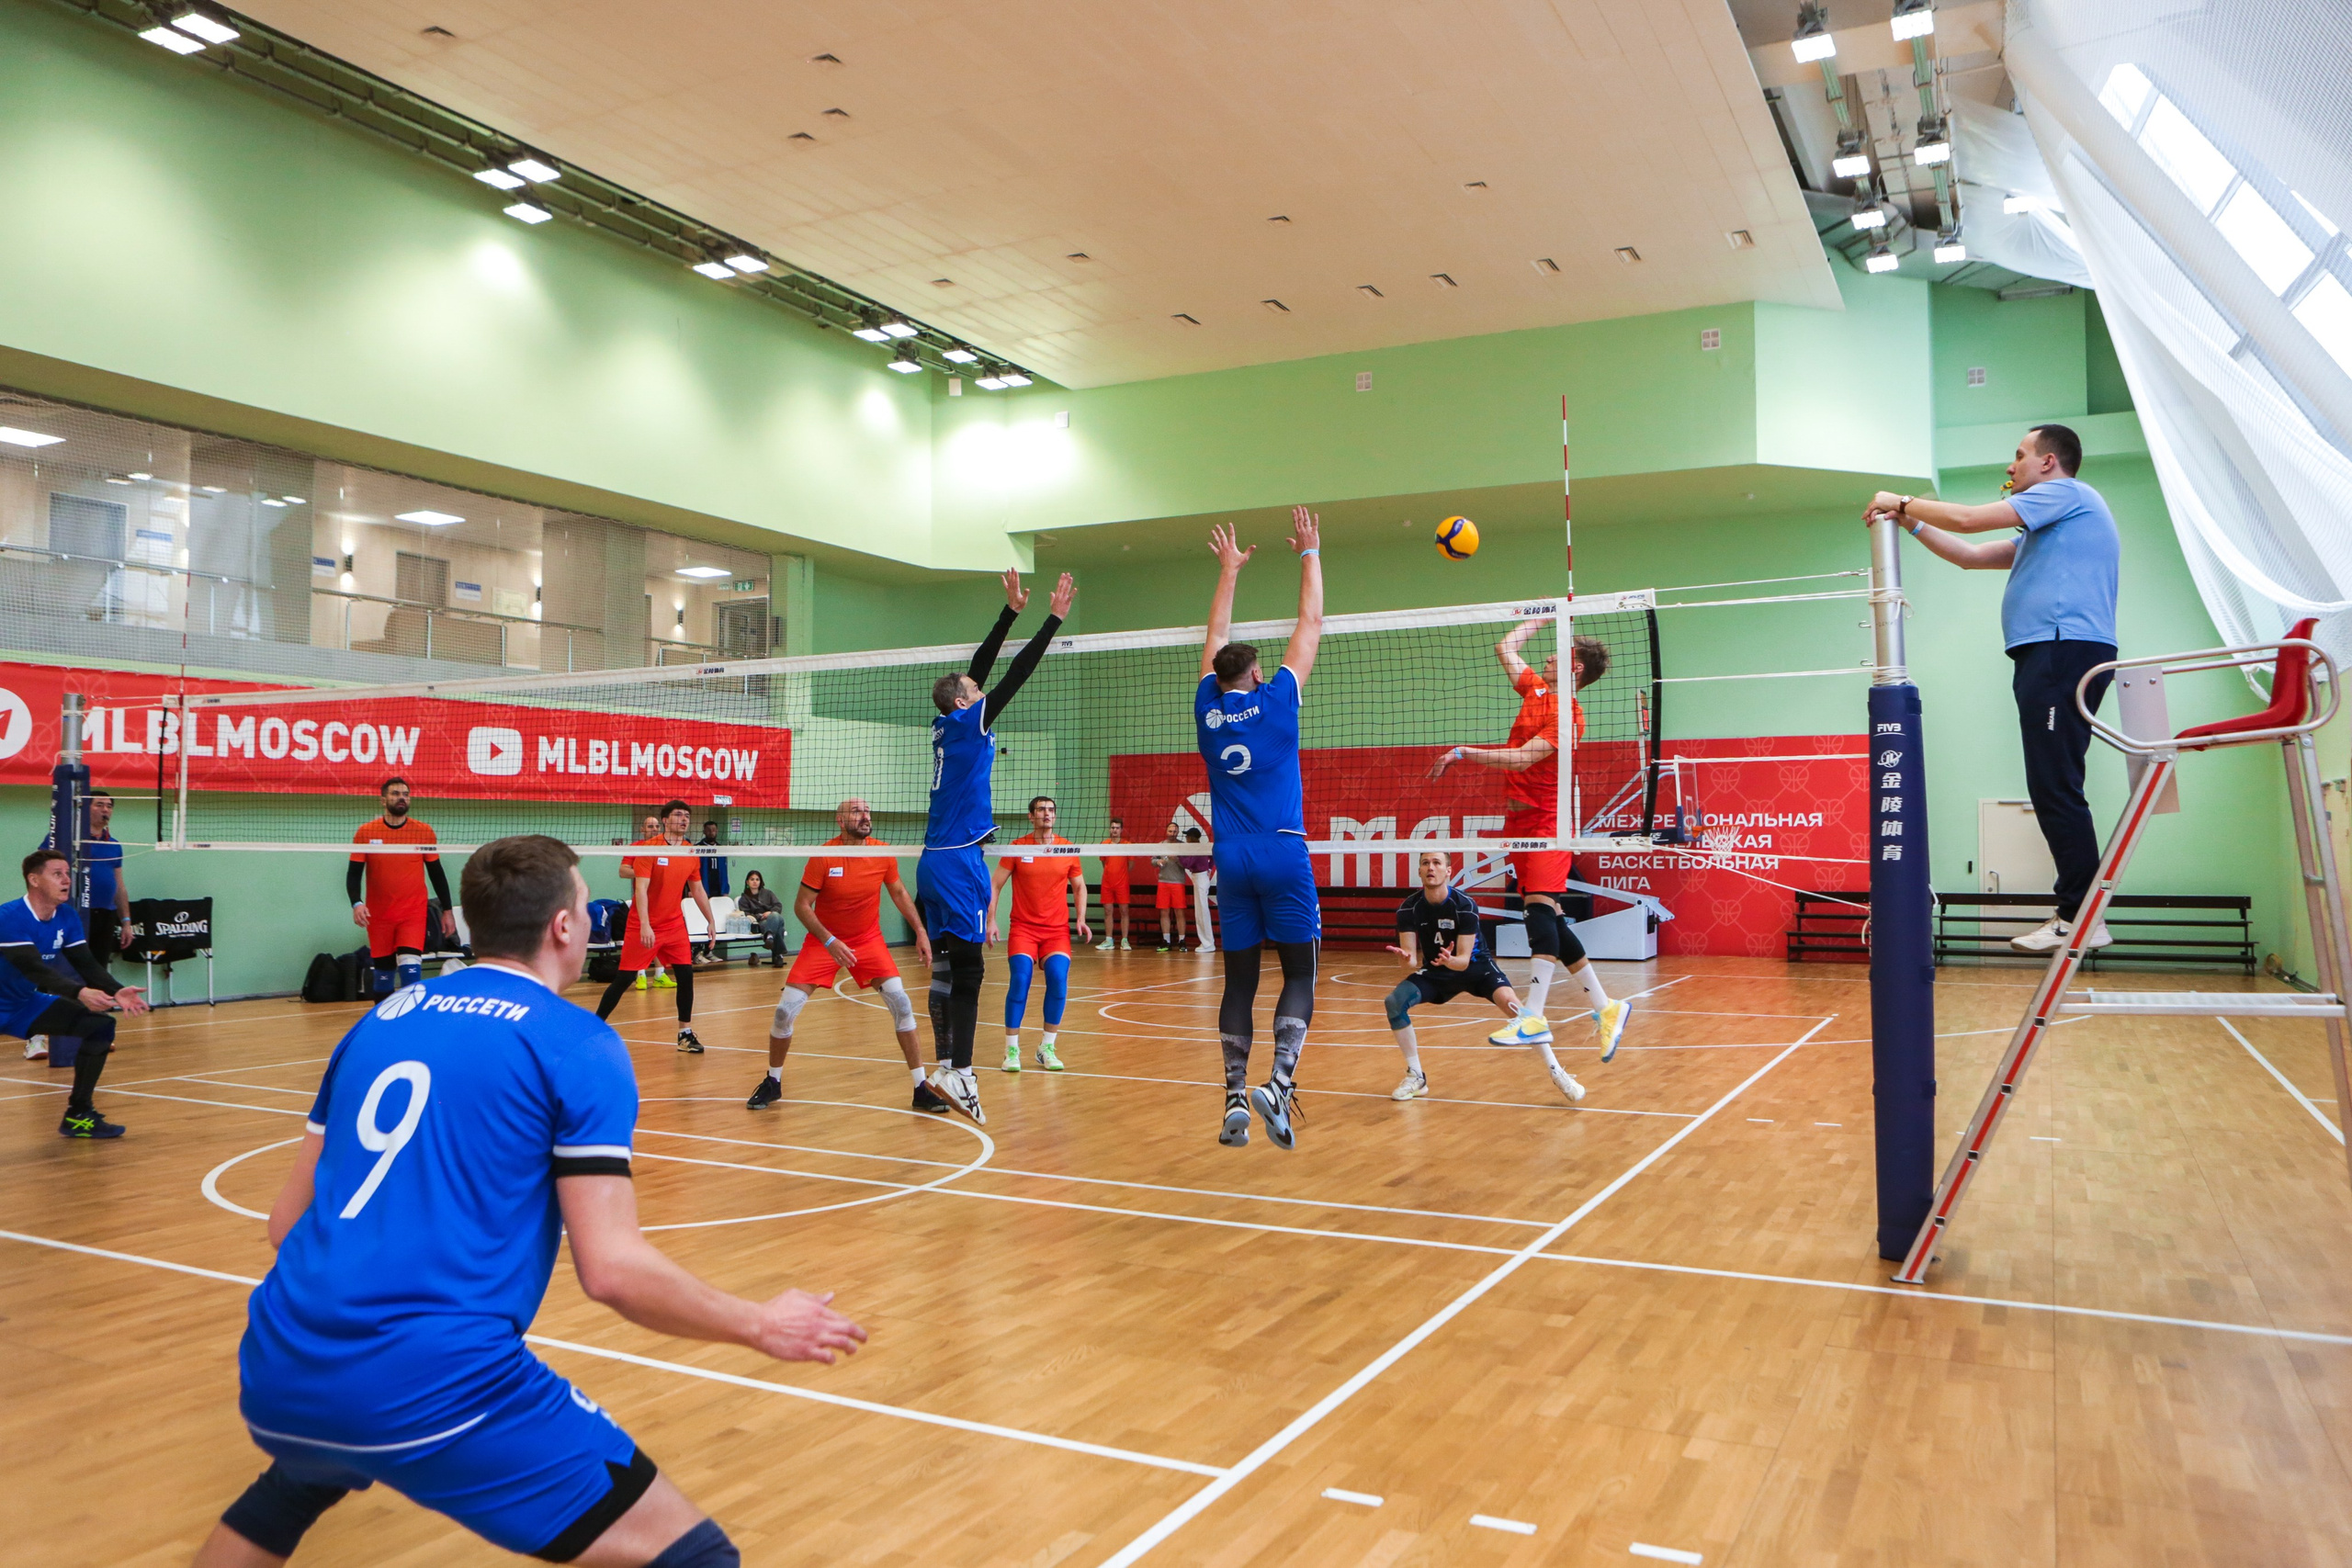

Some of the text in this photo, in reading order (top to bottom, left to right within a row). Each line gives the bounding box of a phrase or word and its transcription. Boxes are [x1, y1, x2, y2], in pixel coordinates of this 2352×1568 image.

[1222, 705, 1261, 724] РОССЕТИ
[62, 705, 421, 766] MLBLMOSCOW
[1877, 723, 1902, 733] FIVB
[537, 736, 759, 782] MLBLMOSCOW
[1881, 772, 1904, 861] 金陵体育
[1599, 855, 1779, 870] БАСКЕТБОЛЬНАЯ
[1600, 875, 1651, 890] ЛИГА
[155, 919, 209, 936] SPALDING
[1434, 931, 1444, 945] 4
[422, 995, 530, 1021] РОССЕТИ
[339, 1060, 431, 1219] 9
